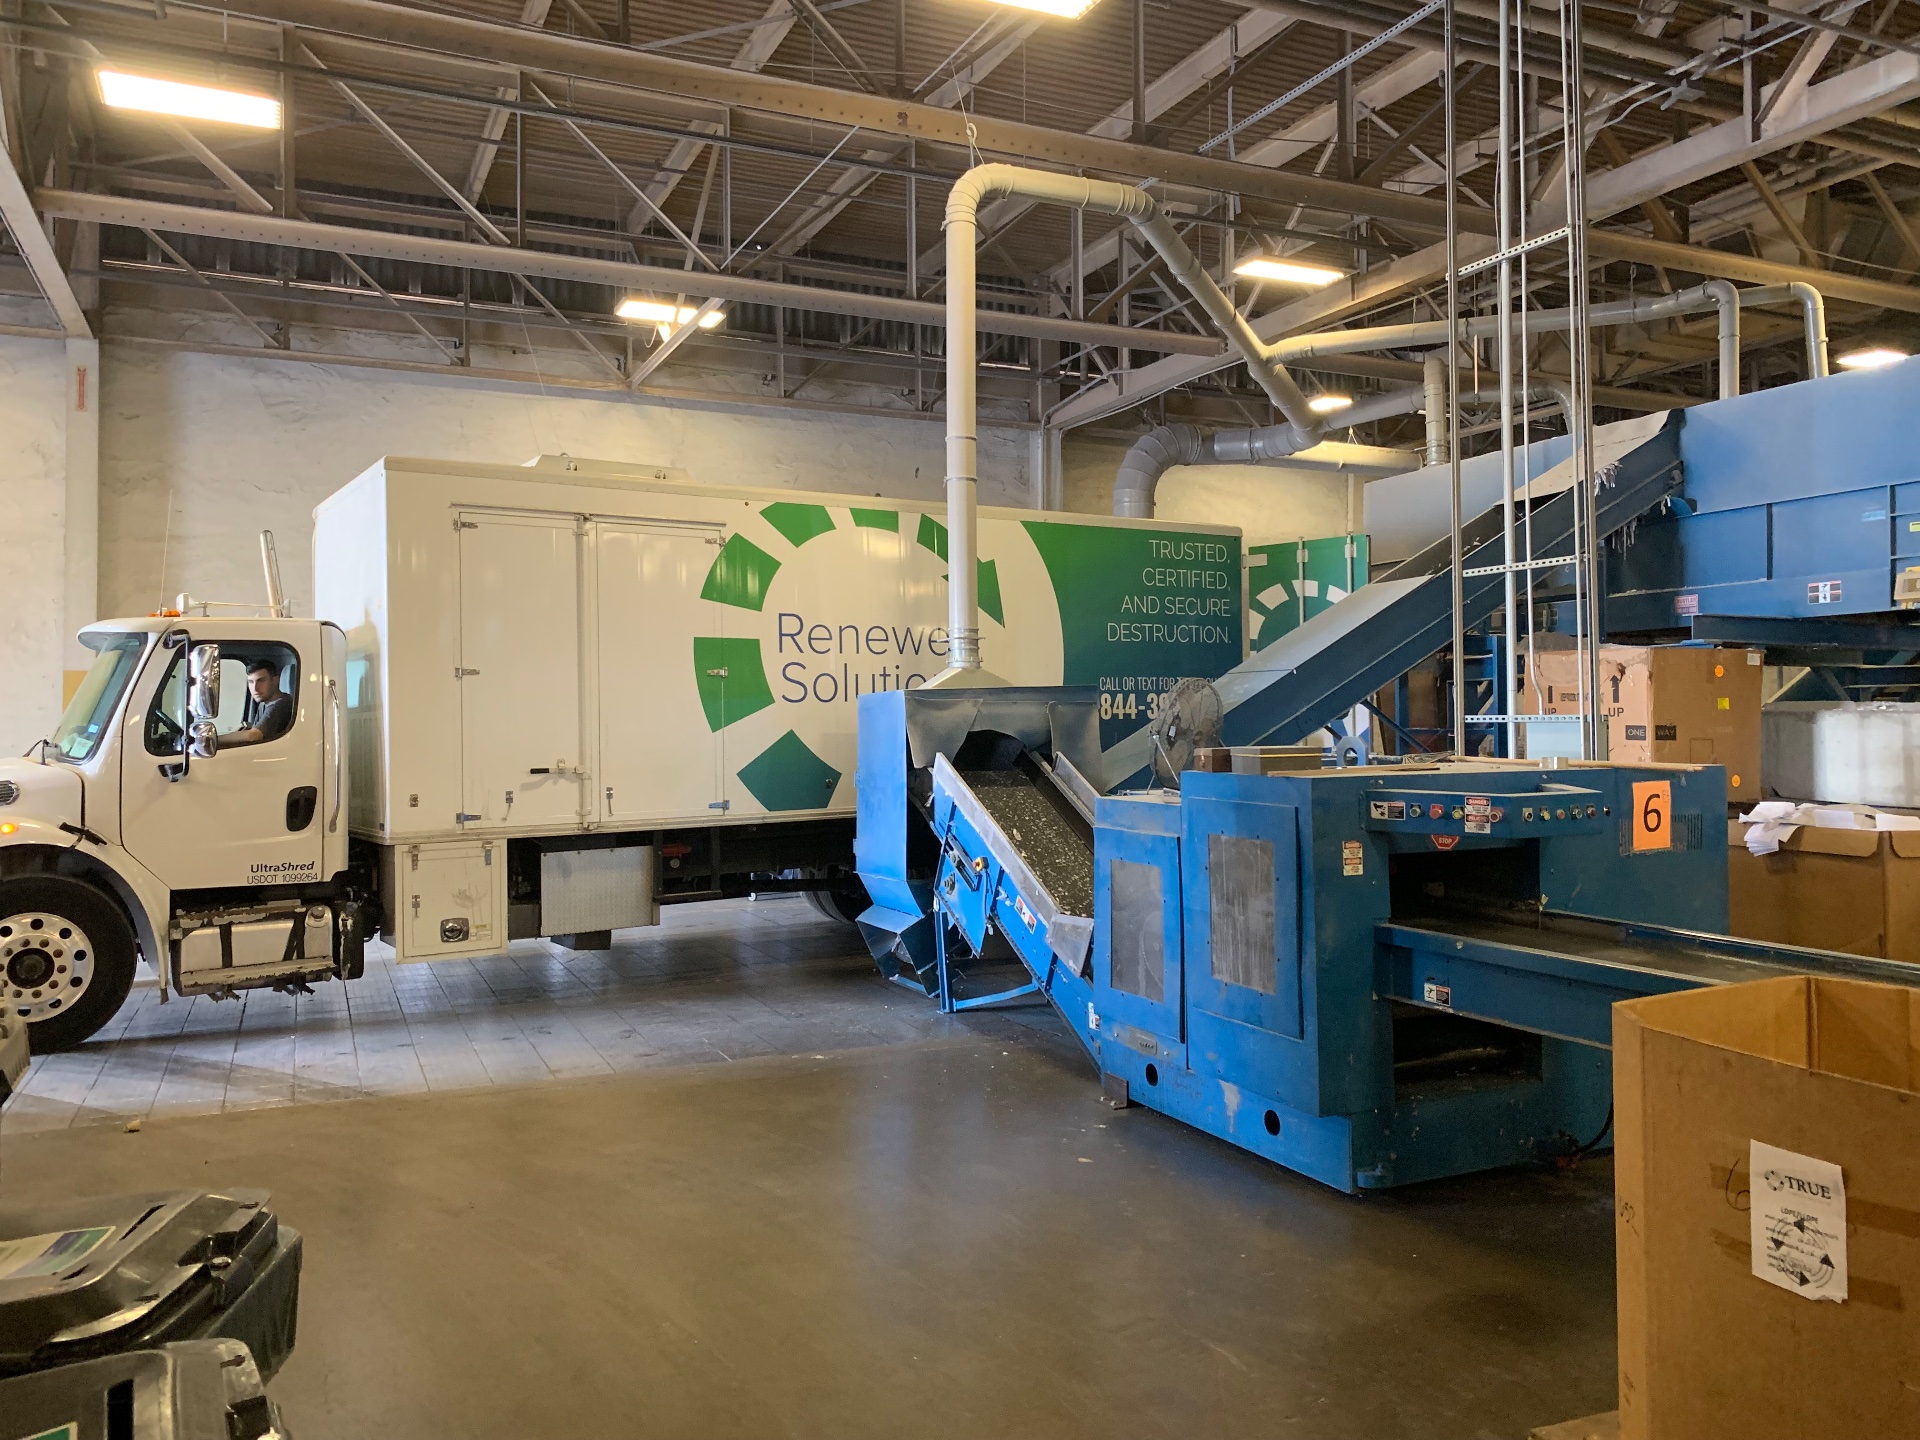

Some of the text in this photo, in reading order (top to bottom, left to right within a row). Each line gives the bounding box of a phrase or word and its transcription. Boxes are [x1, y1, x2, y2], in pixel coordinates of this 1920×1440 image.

[1149, 540, 1231, 564] TRUSTED,
[1142, 568, 1231, 591] CERTIFIED,
[1121, 595, 1231, 616] AND SECURE
[778, 612, 951, 657] Renewe
[1106, 622, 1232, 643] DESTRUCTION.
[781, 661, 930, 704] Soluti
[1100, 676, 1176, 691] CALL OR TEXT FOR
[1608, 707, 1625, 718] UP
[1627, 728, 1677, 737] ONE WAY
[1643, 793, 1662, 833] 6
[1438, 837, 1453, 845] STOP
[250, 860, 315, 873] UltraShred
[246, 872, 318, 885] USDOT 1099264
[1784, 1175, 1832, 1200] TRUE
